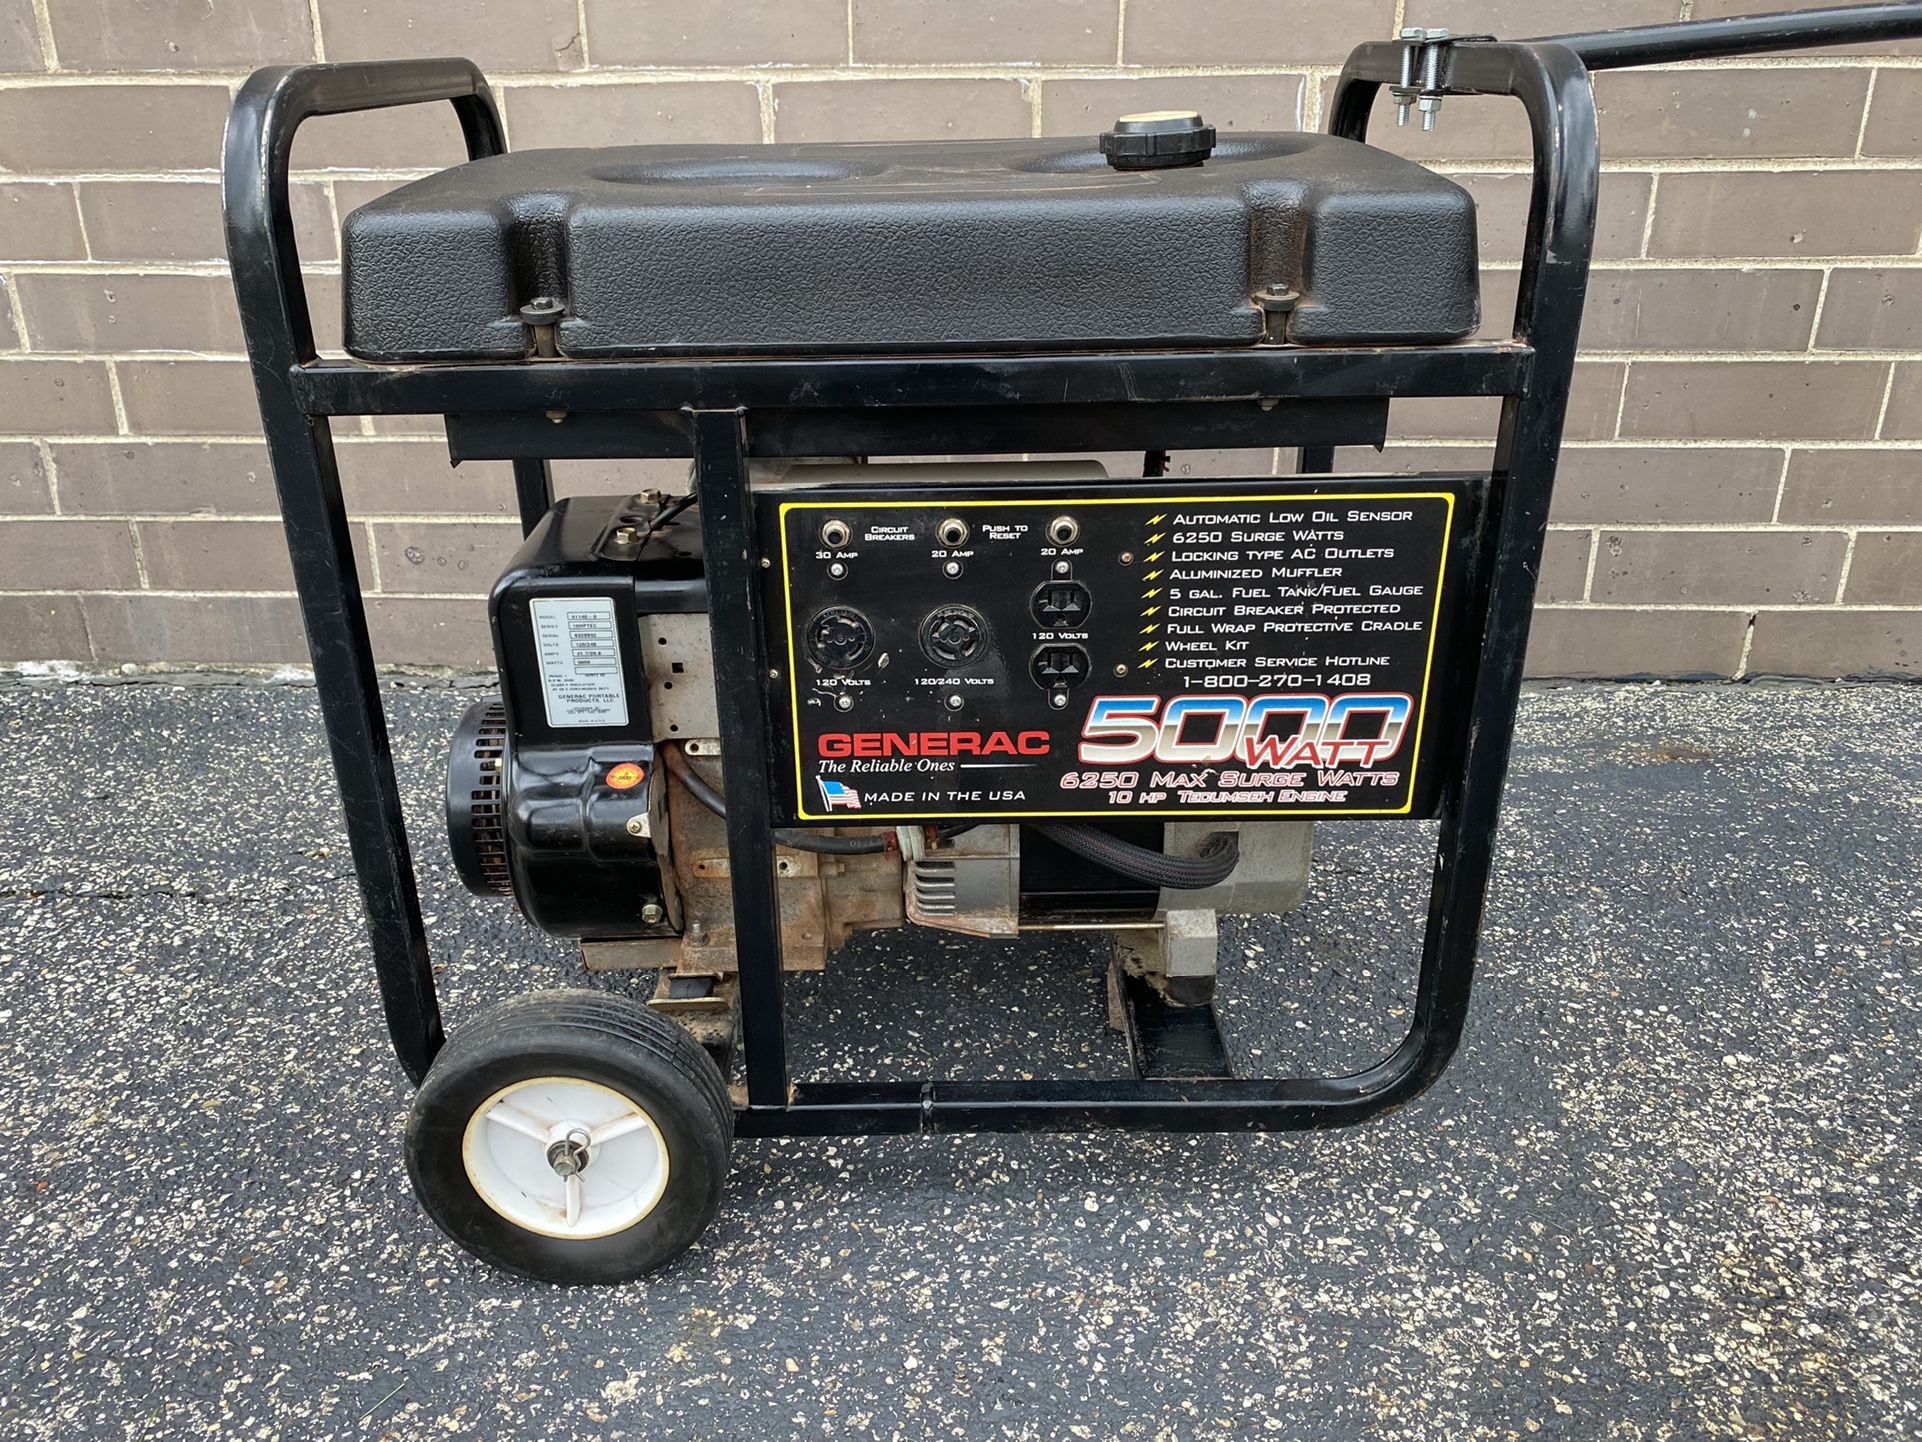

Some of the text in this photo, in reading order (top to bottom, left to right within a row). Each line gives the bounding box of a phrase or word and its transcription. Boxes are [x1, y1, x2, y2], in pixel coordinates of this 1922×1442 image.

[1172, 510, 1413, 525] AUTOMATIC LOW OIL SENSOR
[870, 526, 909, 534] CIRCUIT
[982, 524, 1029, 533] PUSH TO
[864, 533, 916, 541] BREAKERS
[989, 532, 1022, 540] RESET
[1172, 530, 1344, 544] 6250 SURGE WATTS
[815, 550, 858, 559] 30 AMP
[931, 549, 974, 558] 20 AMP
[1040, 547, 1084, 556] 20 AMP
[1171, 548, 1394, 562] LOCKING TYPE AC OUTLETS
[1169, 567, 1343, 580] ALUMINIZED MUFFLER
[1169, 584, 1424, 600] 5 GAL. FUEL TANK/FUEL GAUGE
[1168, 603, 1401, 617] CIRCUIT BREAKER PROTECTED
[1166, 620, 1423, 635] FULL WRAP PROTECTIVE CRADLE
[1031, 632, 1089, 640] 120 VOLTS
[1165, 639, 1250, 652] WHEEL KIT
[1165, 655, 1391, 669] CUSTOMER SERVICE HOTLINE
[914, 677, 994, 686] 120/240 VOLTS
[1183, 673, 1371, 688] 1-800-270-1408
[1077, 691, 1415, 766] 5000
[818, 730, 1051, 758] GENERAC
[1242, 735, 1391, 770] WATT
[818, 758, 955, 774] The Reliable Ones
[1059, 770, 1400, 790] 6250 MAX SURGE WATTS
[864, 790, 1026, 802] MADE IN THE USA
[1107, 790, 1349, 805] 10 HP TECUMSEH ENGINE
